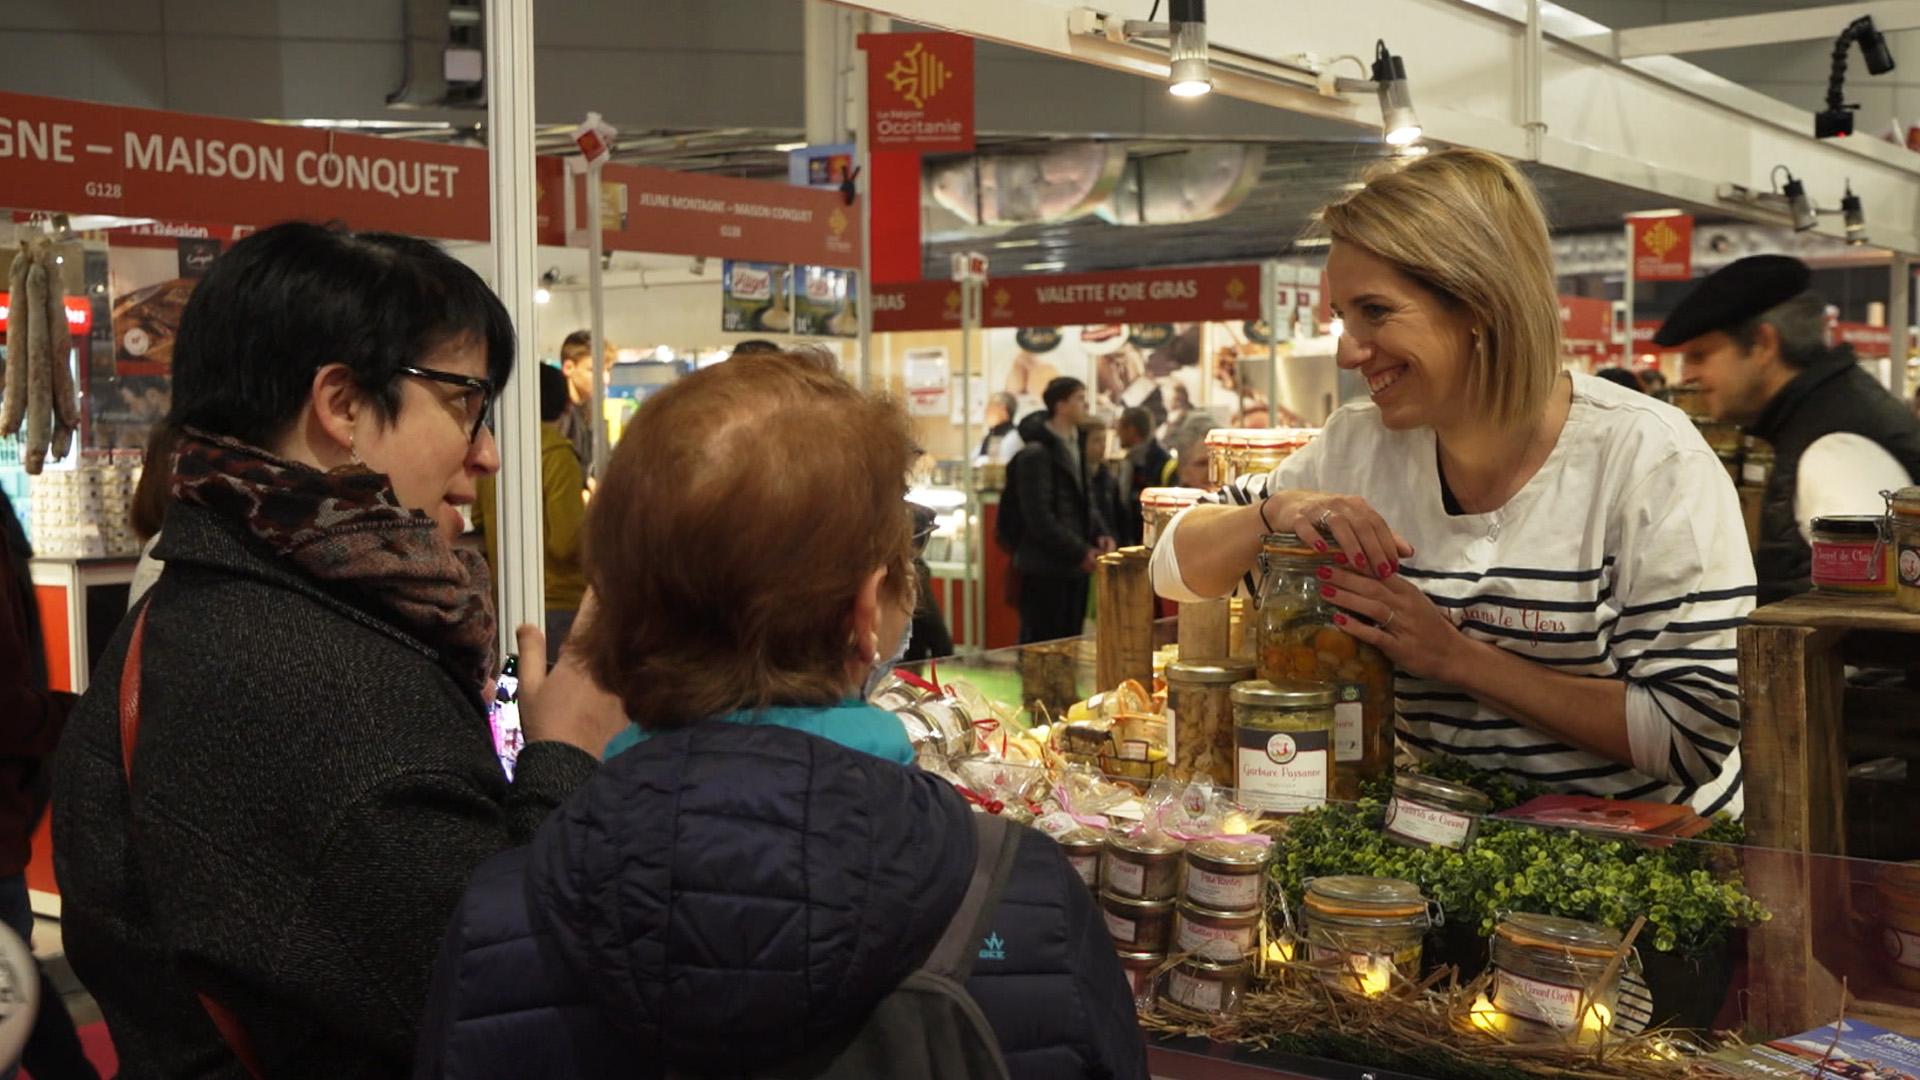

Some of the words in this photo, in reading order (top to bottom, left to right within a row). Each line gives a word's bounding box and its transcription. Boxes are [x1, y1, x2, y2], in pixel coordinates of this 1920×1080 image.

[877, 119, 962, 135] Occitanie
[125, 132, 284, 183] MAISON
[296, 150, 459, 199] CONQUET
[85, 181, 122, 199] G128
[1036, 283, 1104, 304] VALETTE
[1108, 281, 1145, 300] FOIE
[1150, 279, 1198, 299] GRAS
[1498, 611, 1513, 628] le
[1243, 763, 1278, 777] Garbure
[1281, 765, 1321, 780] Paysanne
